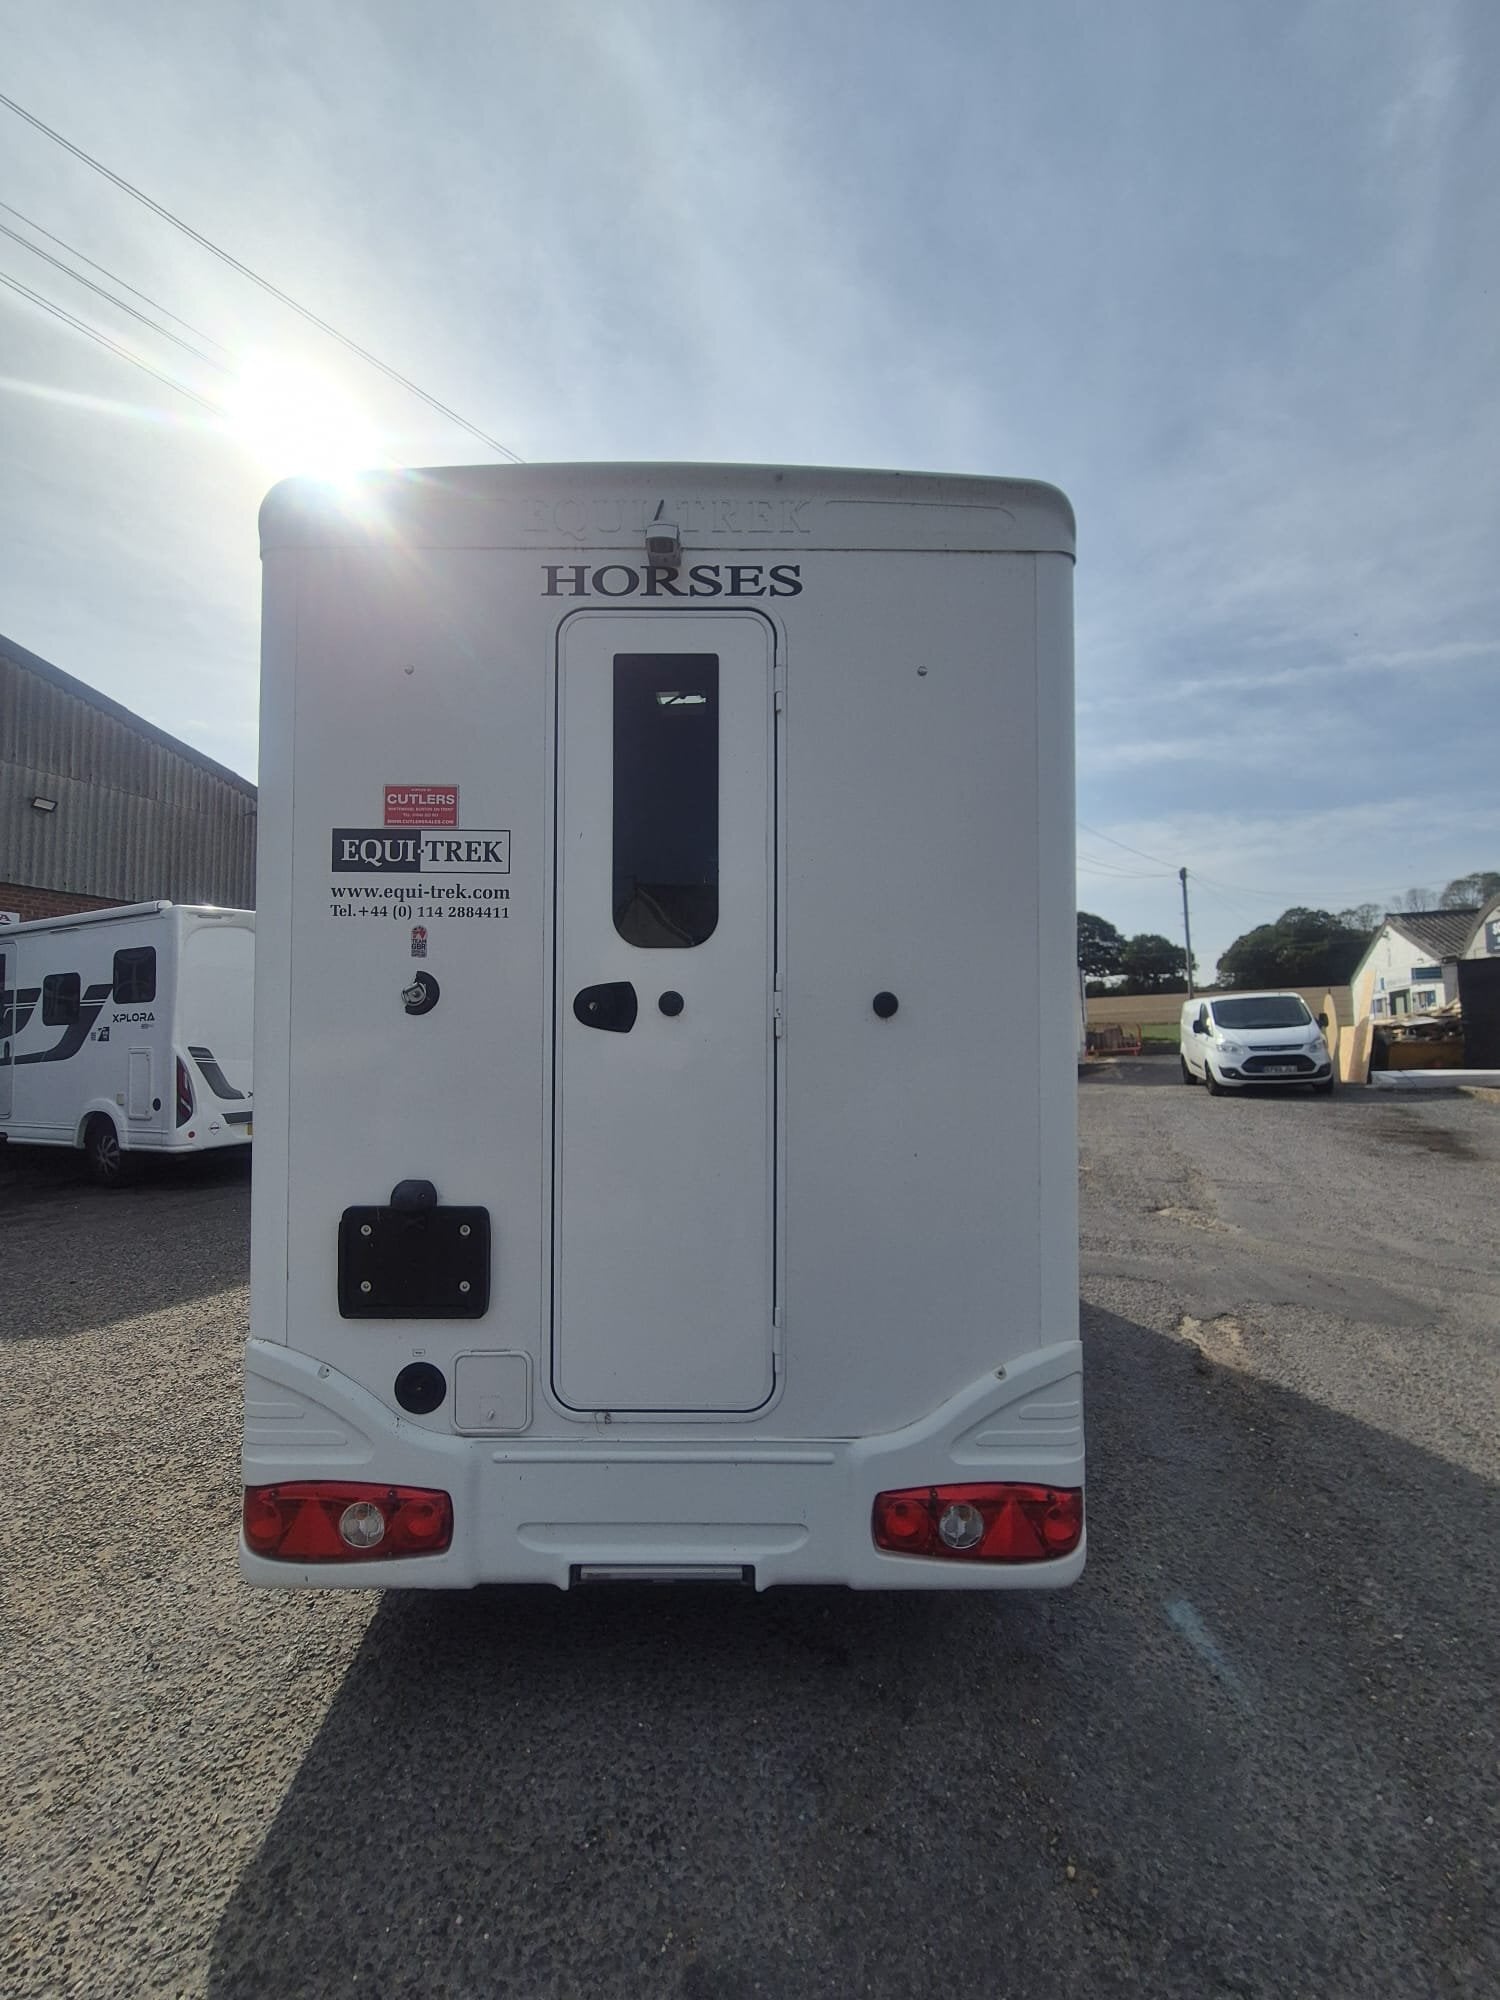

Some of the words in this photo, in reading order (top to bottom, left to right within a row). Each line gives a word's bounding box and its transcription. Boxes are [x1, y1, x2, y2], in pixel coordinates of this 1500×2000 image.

[540, 564, 804, 598] HORSES
[387, 793, 456, 805] CUTLERS
[331, 883, 511, 903] www.equi-trek.com
[330, 904, 388, 918] Tel.+44
[392, 905, 412, 921] (0)
[417, 906, 444, 919] 114
[448, 907, 510, 919] 2884411
[112, 1012, 156, 1023] XPLORA
